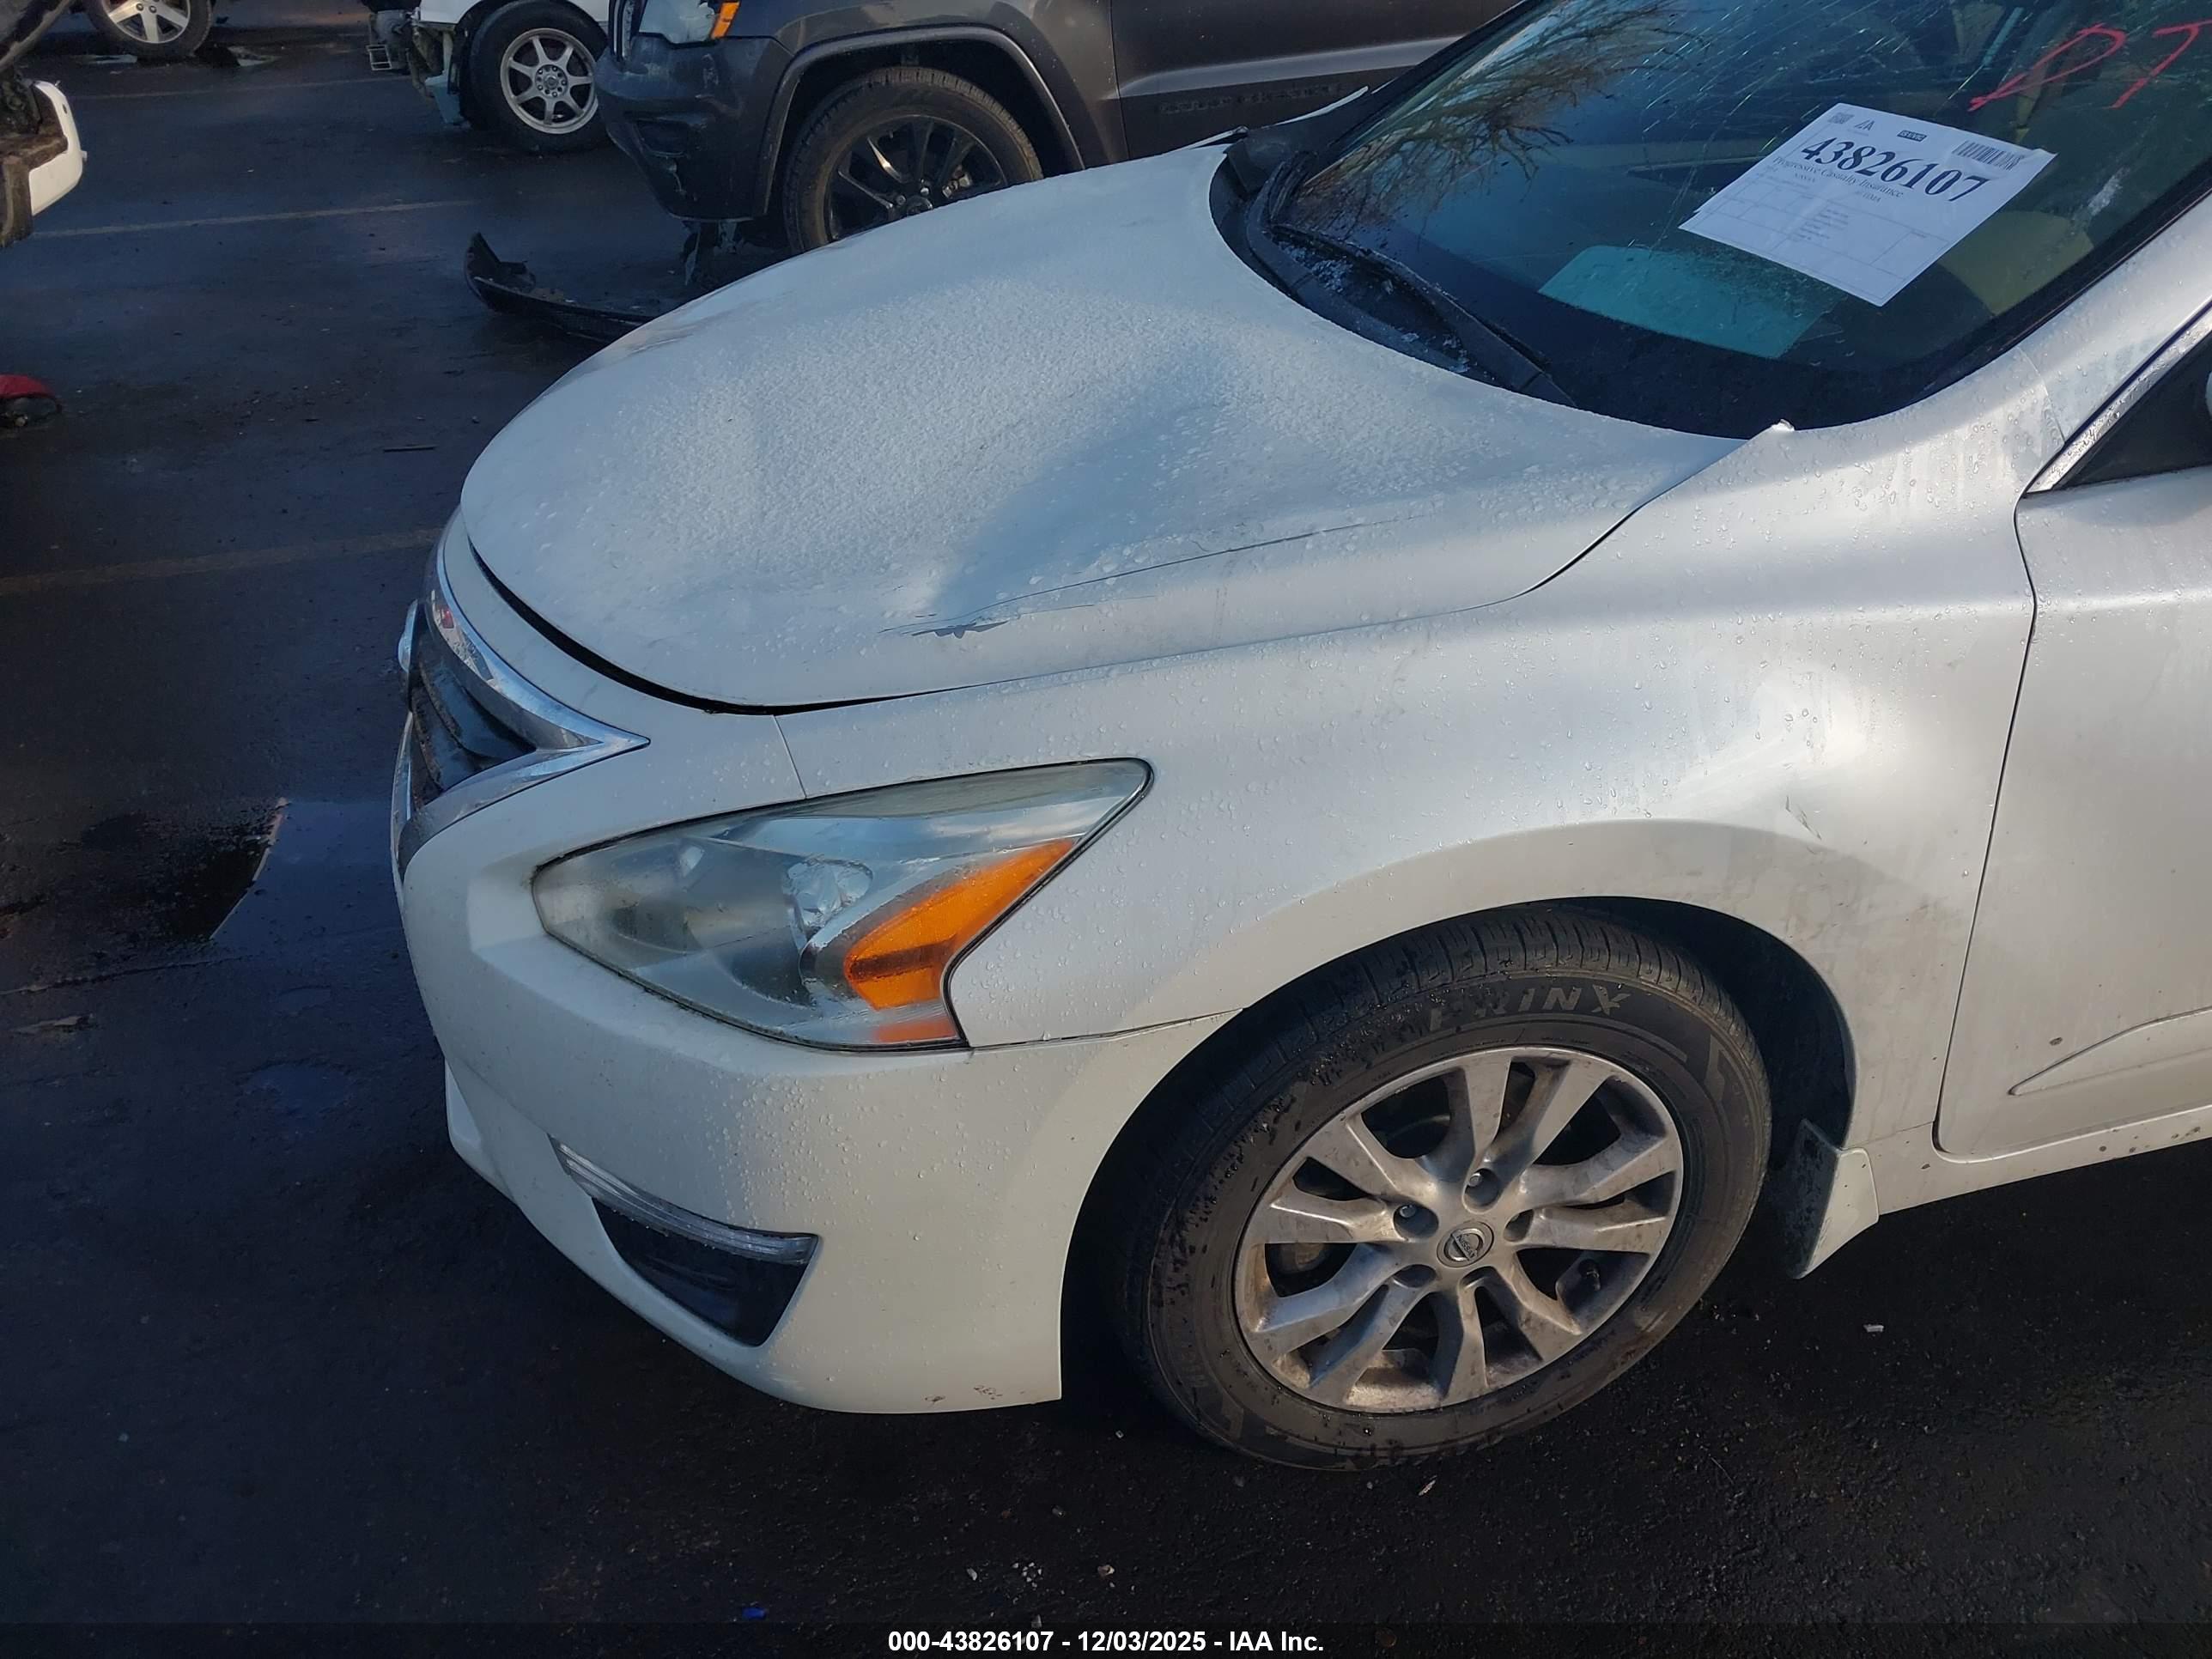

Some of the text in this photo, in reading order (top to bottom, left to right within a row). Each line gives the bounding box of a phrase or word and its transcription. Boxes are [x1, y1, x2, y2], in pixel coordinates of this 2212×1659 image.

[1772, 156, 1821, 174] Progressive
[1821, 168, 1858, 186] Casualty
[1859, 179, 1905, 198] Insurance
[1802, 137, 1991, 202] 43826107
